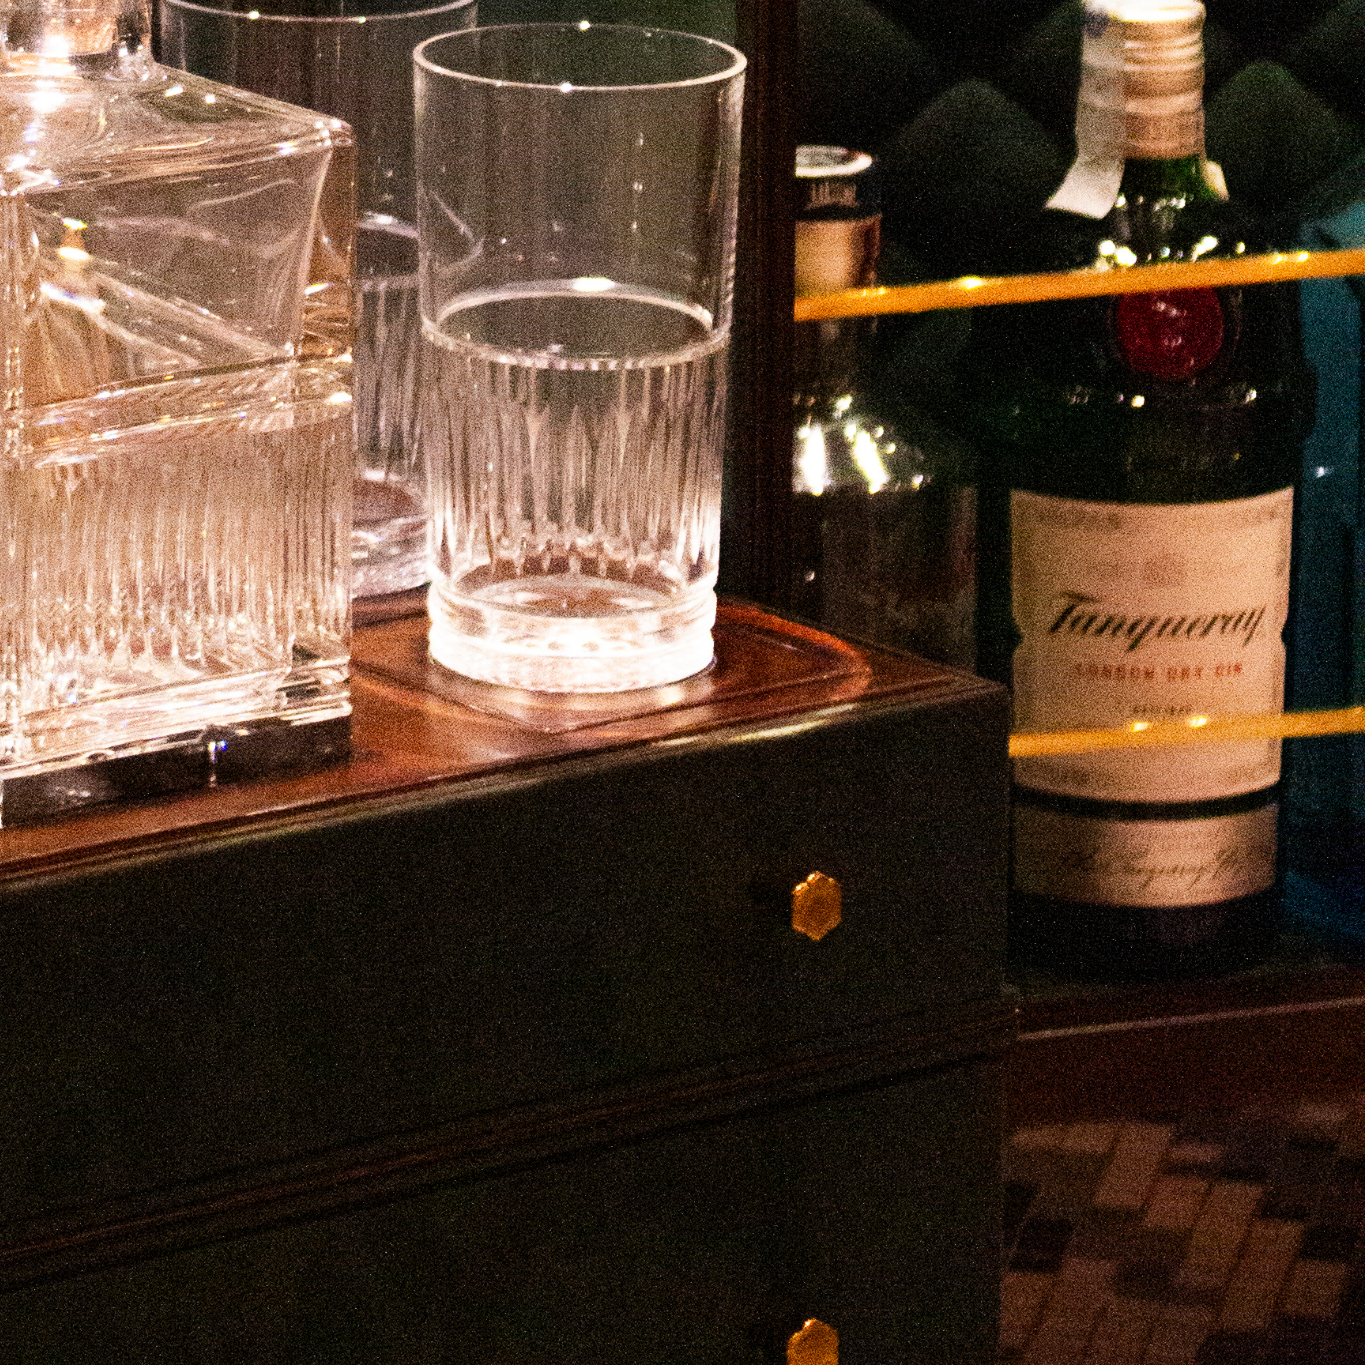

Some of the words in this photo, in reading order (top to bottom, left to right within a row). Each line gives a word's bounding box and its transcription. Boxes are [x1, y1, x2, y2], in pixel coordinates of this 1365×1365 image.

[1048, 591, 1266, 653] Tanqueray
[1074, 662, 1154, 681] LONDON
[1166, 666, 1203, 682] DRY
[1214, 662, 1242, 679] GIN
